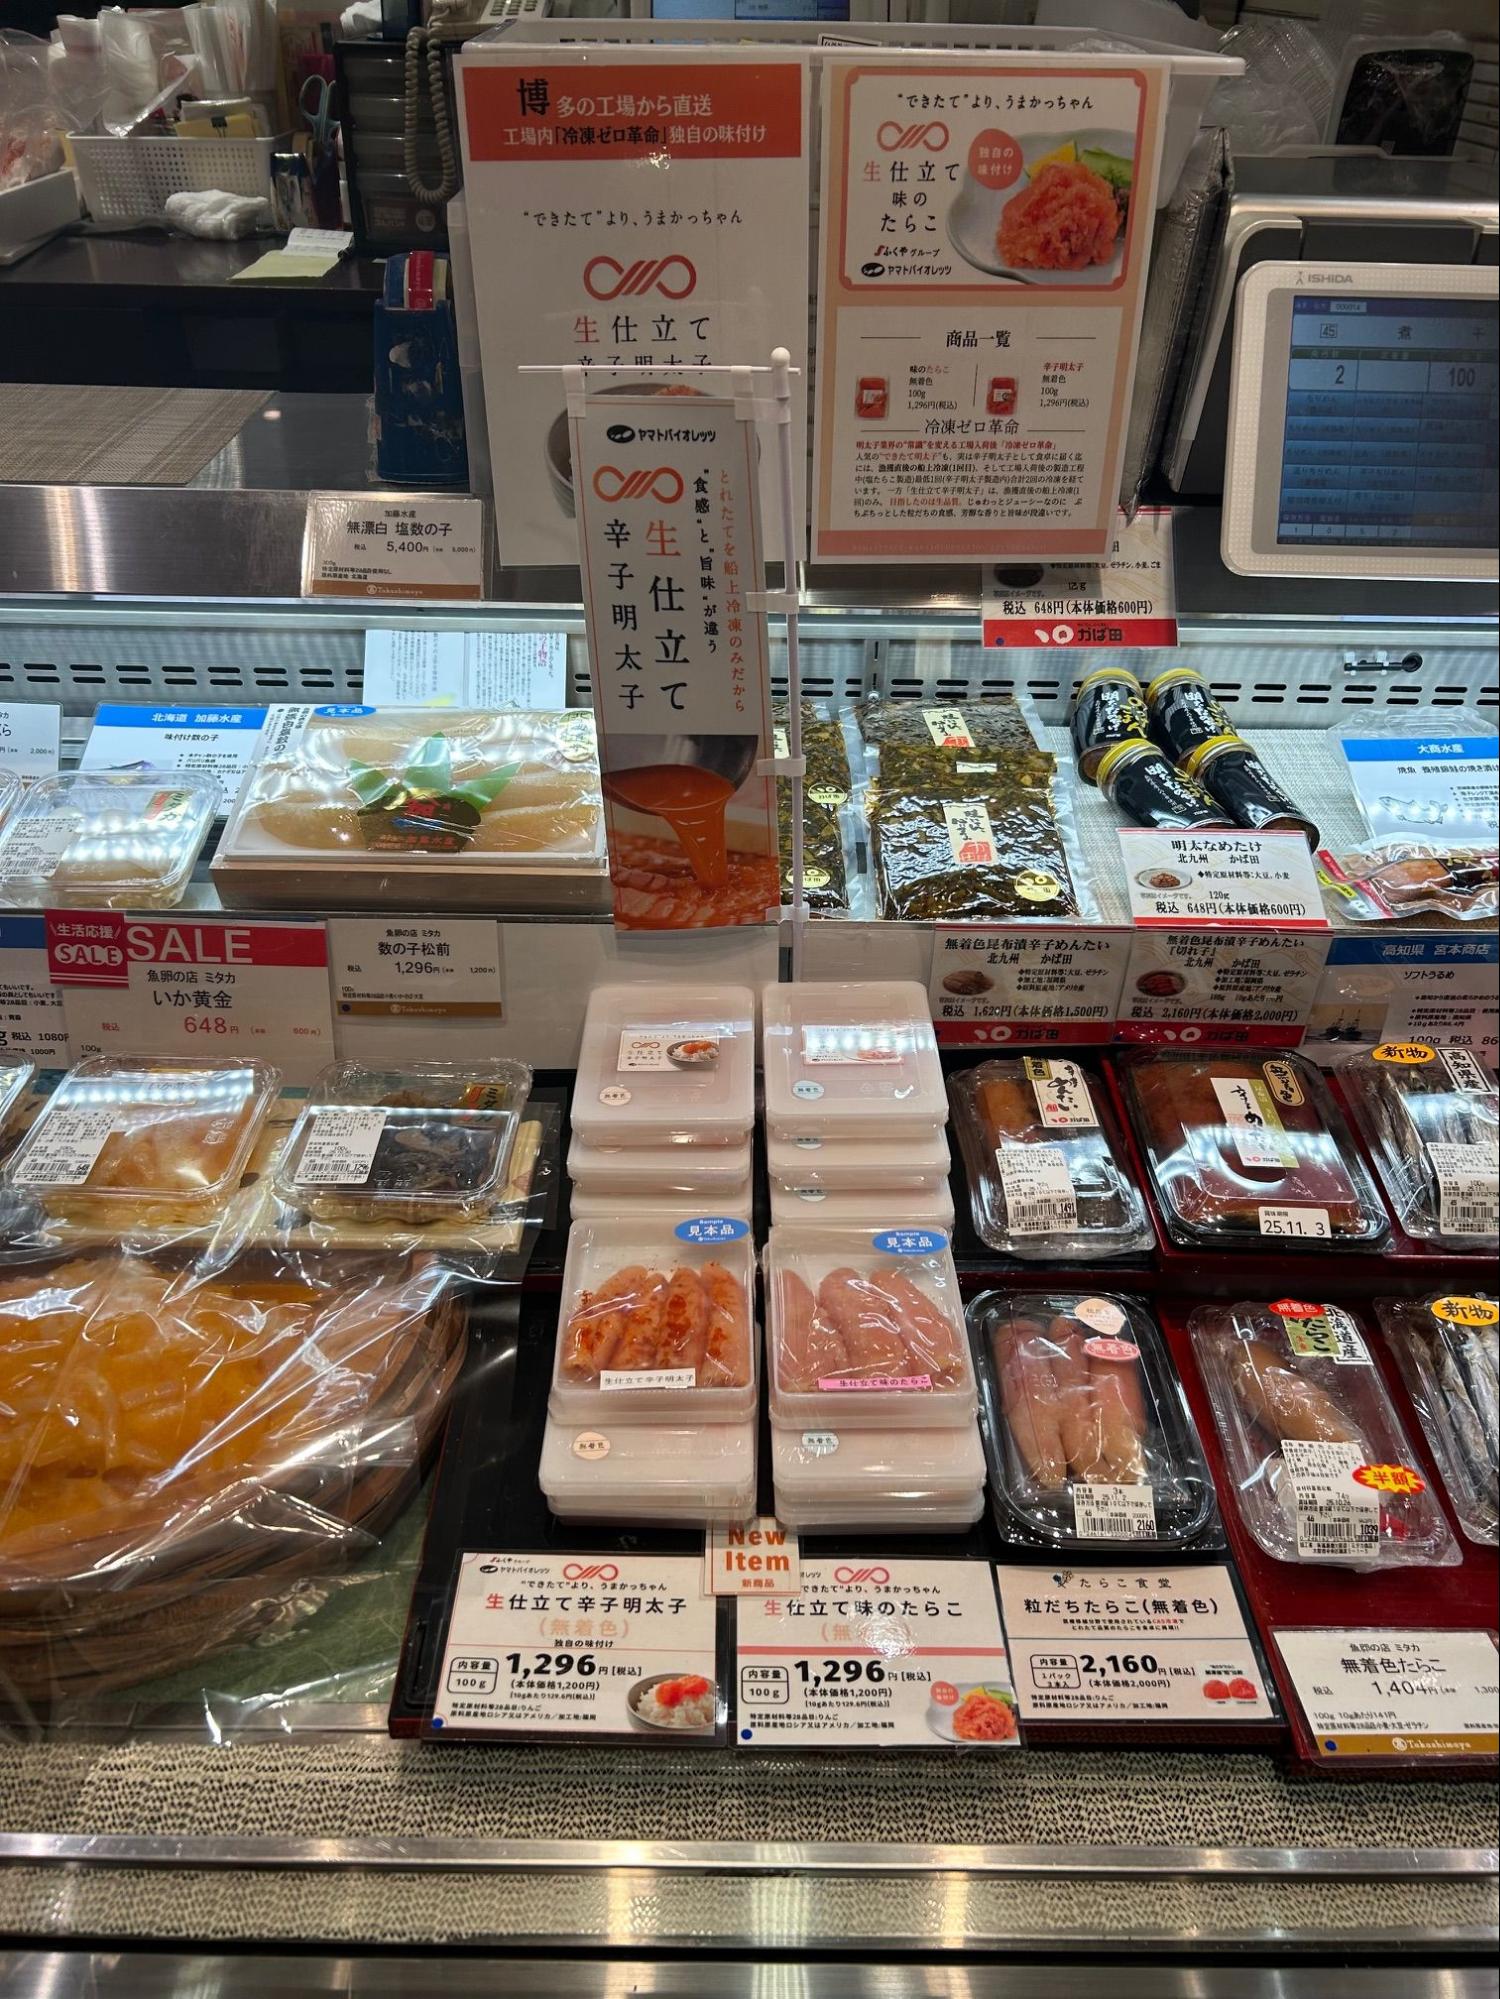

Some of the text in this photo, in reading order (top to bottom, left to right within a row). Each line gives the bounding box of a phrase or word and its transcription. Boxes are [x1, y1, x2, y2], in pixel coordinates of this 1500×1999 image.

[504, 124, 767, 147] 工場内「冷凍ゼロ革命」独自の味付け
[979, 147, 1014, 159] 独自の
[863, 160, 960, 182] 生仕立て
[978, 163, 1013, 175] 味付け
[892, 190, 927, 207] 味の
[880, 213, 937, 233] たらこ
[887, 265, 952, 277] ヤマトバイオレッツ
[1308, 274, 1353, 284] ISHIDA
[574, 314, 711, 344] 生仕立て
[1322, 325, 1337, 337] 45
[946, 330, 1011, 348] 商品一覧
[909, 364, 950, 374] 味のたらこ
[1335, 365, 1345, 385] 2
[909, 376, 933, 386] 無着色
[1042, 374, 1066, 384] 無着色
[1450, 367, 1476, 388] 100
[908, 389, 926, 399] 100g
[1040, 387, 1058, 397] 100g
[907, 400, 957, 411] 1,296円(税込)
[1040, 398, 1090, 409] 1,296円(税込)
[925, 418, 1020, 435] 冷凍ゼロ革命
[638, 428, 716, 442] ヤマトバイオレッツ
[384, 510, 417, 519] 加藤水産
[347, 521, 453, 537] 無漂白 塩数の子
[354, 543, 367, 551] 税込
[719, 470, 746, 713] とれたてを船上冷凍のみだから
[1003, 600, 1153, 615] 税込 648円(本体価格600円)
[603, 518, 645, 711] 辛子明太子
[645, 519, 691, 711] 生仕立て
[152, 713, 242, 723] 北海道 加藤水産
[164, 733, 219, 742] 味付け数の子
[1171, 840, 1262, 852] 明太なめたけ
[1178, 854, 1260, 864] 北九州 かば田
[1209, 891, 1230, 900] 120g
[1156, 902, 1306, 916] 税込 648円(本体価格600円)
[57, 923, 114, 939] 生活応援
[386, 929, 418, 937] 魚卵の店
[126, 924, 253, 964] SALE
[945, 938, 1110, 951] 無着色昆布漬辛子めんたい
[1167, 935, 1304, 948] 無着色昆布漬辛子めんたい
[58, 945, 121, 965] SALE
[377, 942, 450, 957] 数の子松前
[1170, 947, 1217, 957] 「切れ子」
[1383, 944, 1491, 956] 高知県 宮本商店
[987, 953, 1073, 964] 北九州 かば田
[1184, 958, 1261, 969] 北九州 かば田
[347, 961, 440, 975] 税込 1,296円
[147, 970, 236, 984] 魚卵の店 ミタカ
[1404, 970, 1455, 981] ソフトうるめ
[153, 990, 233, 1009] いか黄金
[943, 1005, 965, 1017] 税込
[1131, 1007, 1153, 1017] 税込
[101, 1022, 120, 1032] 税込
[11, 1032, 32, 1041] 税込
[1449, 1035, 1473, 1045] 税込
[1382, 1046, 1428, 1058] 新物
[688, 1224, 735, 1237] 見本品
[887, 1237, 933, 1248] 見本品
[1277, 1303, 1318, 1313] 無着色
[1442, 1302, 1494, 1319] 新物
[1327, 1308, 1363, 1358] 北海道産
[605, 1373, 695, 1387] 生仕立て辛子明太子
[1373, 1472, 1408, 1487] 半額
[1137, 1520, 1155, 1531] 2160
[1360, 1524, 1378, 1535] 1039
[728, 1528, 786, 1545] New
[726, 1551, 789, 1571] Item
[500, 1566, 551, 1574] ヤマトバイオレッツ
[742, 1578, 775, 1588] 新商品
[1079, 1577, 1172, 1589] たらこ食堂
[485, 1593, 687, 1615] 生仕立て辛子明太子
[764, 1599, 963, 1617] 生仕立て味のたらこ
[1023, 1598, 1219, 1616] 粒だちたらこ(無着色)
[539, 1618, 629, 1638] (無着色)
[554, 1639, 614, 1648] 独自の味付け
[1350, 1643, 1420, 1652] 魚卵の店 ミタカ
[457, 1661, 492, 1671] 内容量
[1040, 1657, 1068, 1667] 内容量
[1341, 1657, 1447, 1674] 無着色たらこ
[748, 1670, 782, 1680] 内容量
[510, 1679, 600, 1691] (本体価格1,200円)
[1089, 1679, 1171, 1689] (本体価格2,000円)
[803, 1687, 892, 1698] (本体価格1,200円)
[1312, 1686, 1334, 1695] 税込
[1408, 1740, 1472, 1749] Takashimaya
